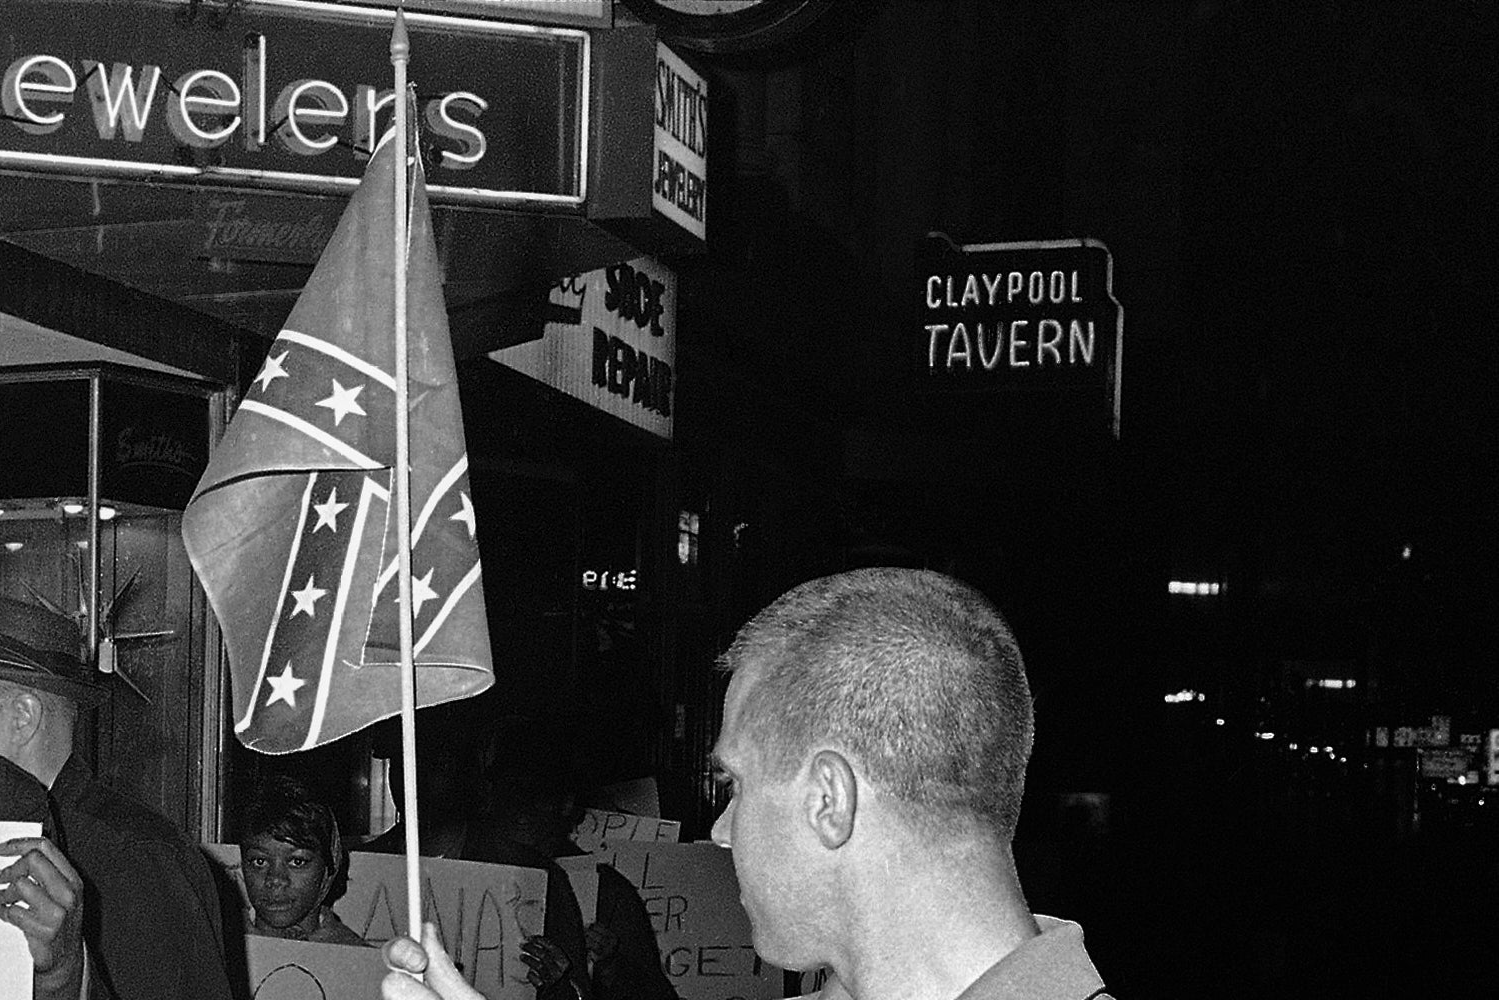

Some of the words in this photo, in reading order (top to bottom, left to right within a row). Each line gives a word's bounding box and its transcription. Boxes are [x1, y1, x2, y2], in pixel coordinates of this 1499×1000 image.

[926, 269, 1084, 309] CLAYPOOL
[592, 326, 673, 418] REPAIR
[924, 319, 1096, 373] TAVERN
